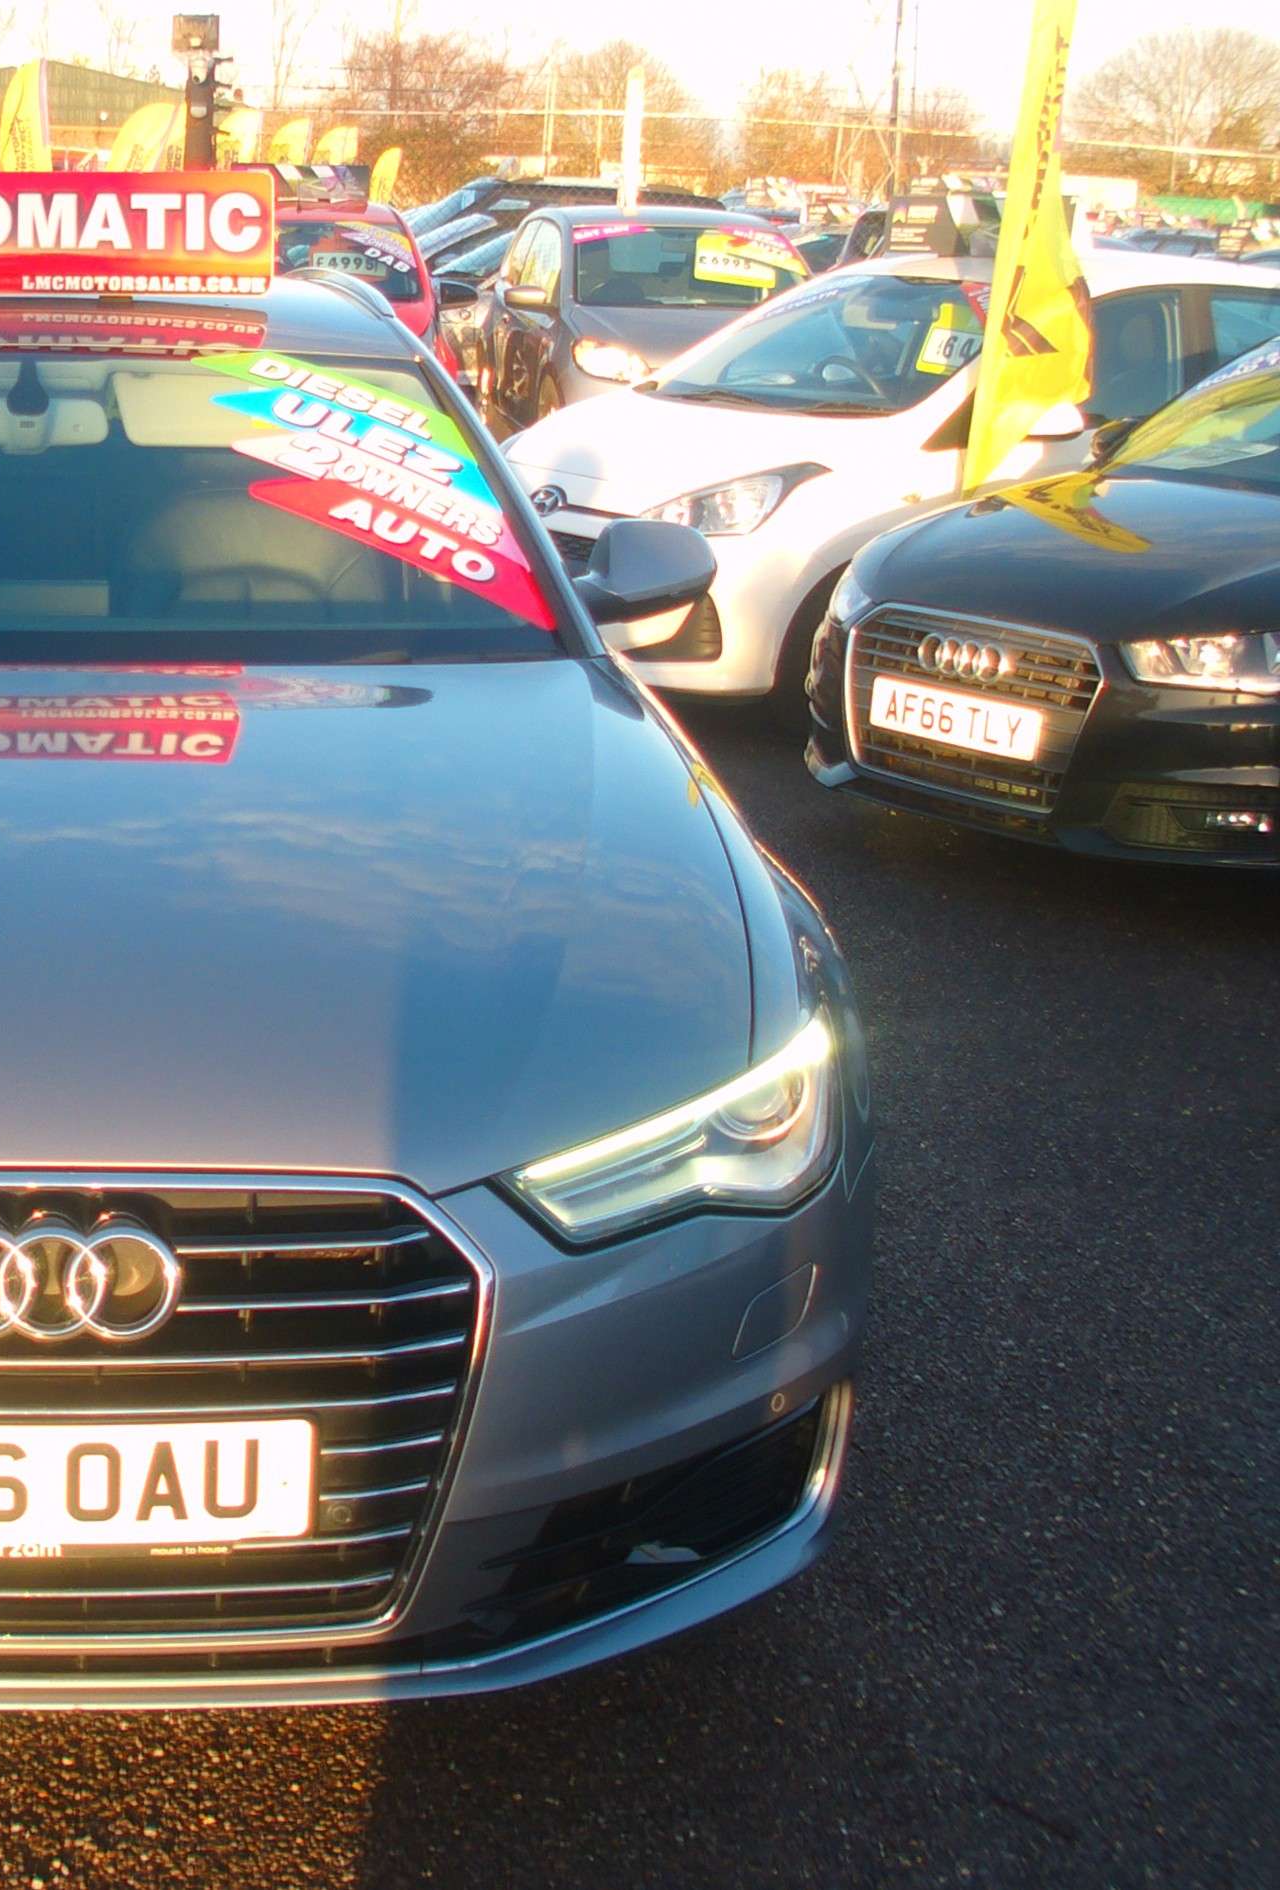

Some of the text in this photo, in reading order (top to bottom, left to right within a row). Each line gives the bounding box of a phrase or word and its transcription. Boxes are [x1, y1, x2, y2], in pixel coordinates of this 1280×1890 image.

[22, 275, 266, 293] LMCMOTORSALES.CO.UK
[248, 356, 434, 441] DIESEL
[271, 392, 464, 486] ULEZ
[328, 497, 497, 584] AUTO
[884, 688, 1023, 749] AF66 TLY
[65, 1438, 260, 1522] OAU
